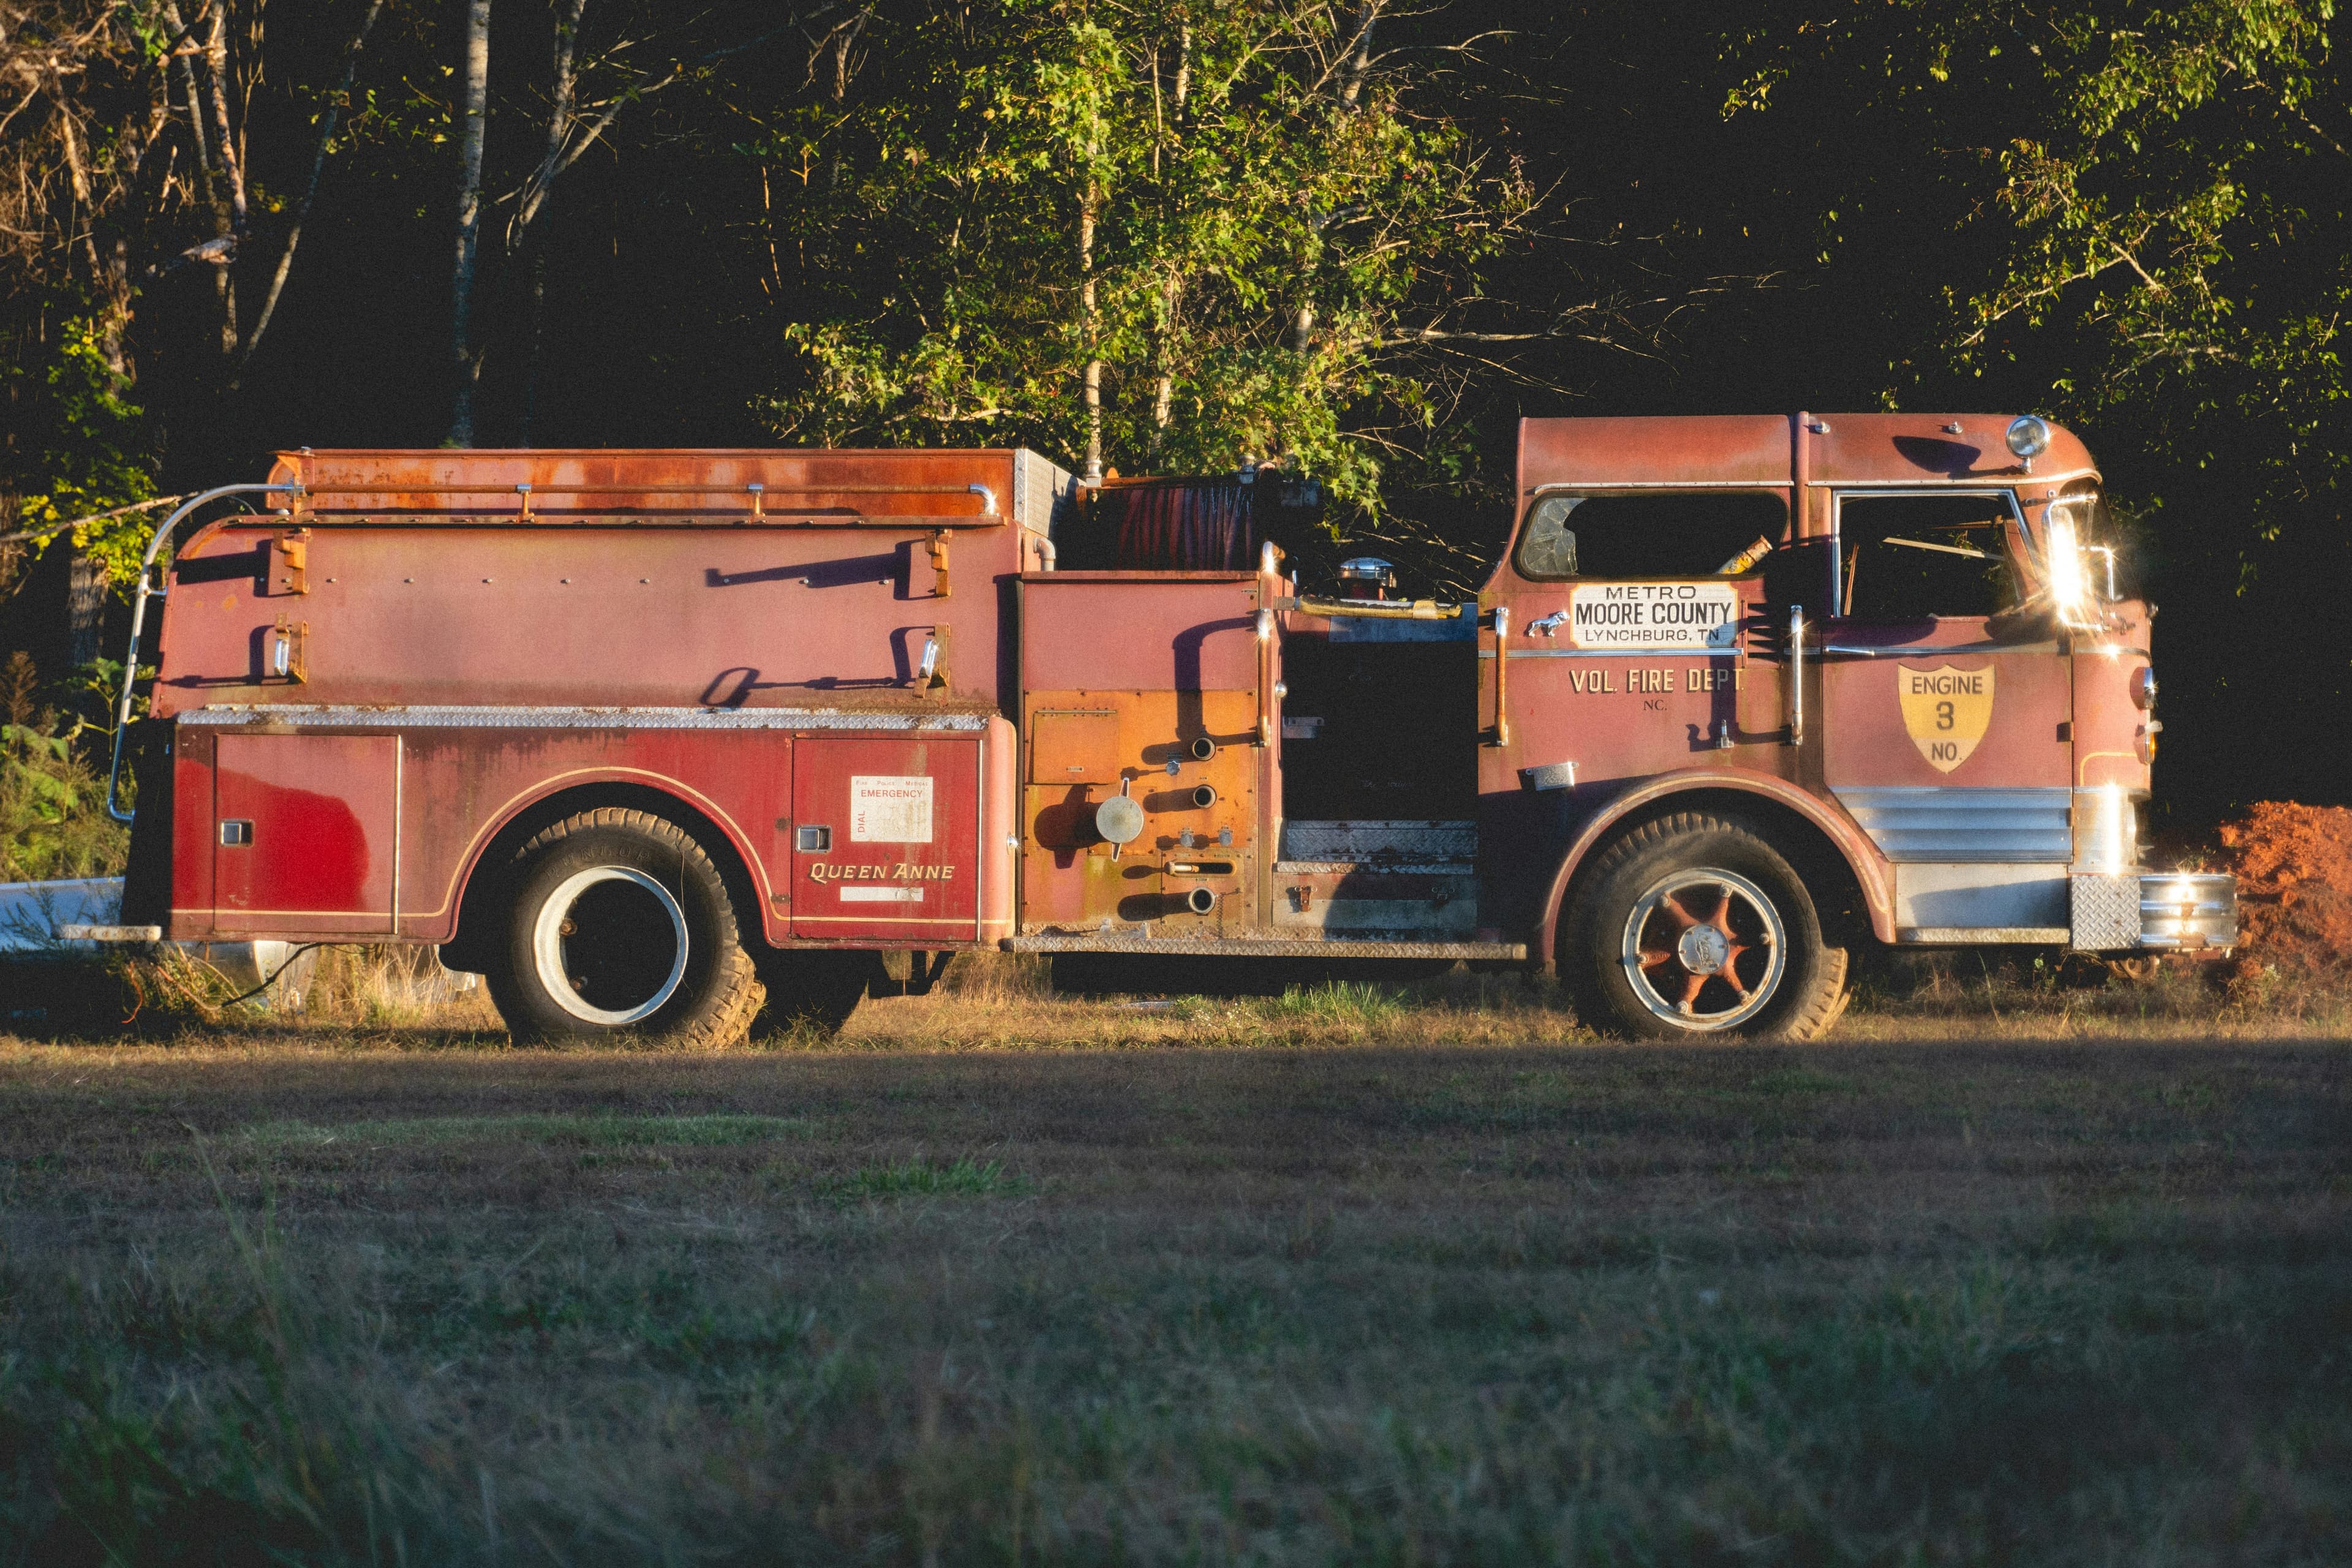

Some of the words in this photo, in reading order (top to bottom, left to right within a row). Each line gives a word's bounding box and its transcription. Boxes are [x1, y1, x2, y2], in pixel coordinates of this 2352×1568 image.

[1606, 586, 1697, 600] METRO
[1575, 603, 1643, 625] MOORE
[1652, 602, 1732, 625] COUNTY
[1585, 629, 1692, 643] LYNCHBURG,
[1698, 628, 1719, 641] TN
[1569, 669, 1618, 693] VOL.
[1627, 669, 1674, 693] FIRE
[1687, 668, 1744, 692] DEPT.
[1912, 676, 1983, 695] ENGINE
[1643, 699, 1668, 711] NC.
[1936, 701, 1954, 731] 3
[861, 790, 923, 798] EMERGENCY
[809, 862, 888, 884] QUEEN
[892, 862, 956, 880] ANNE
